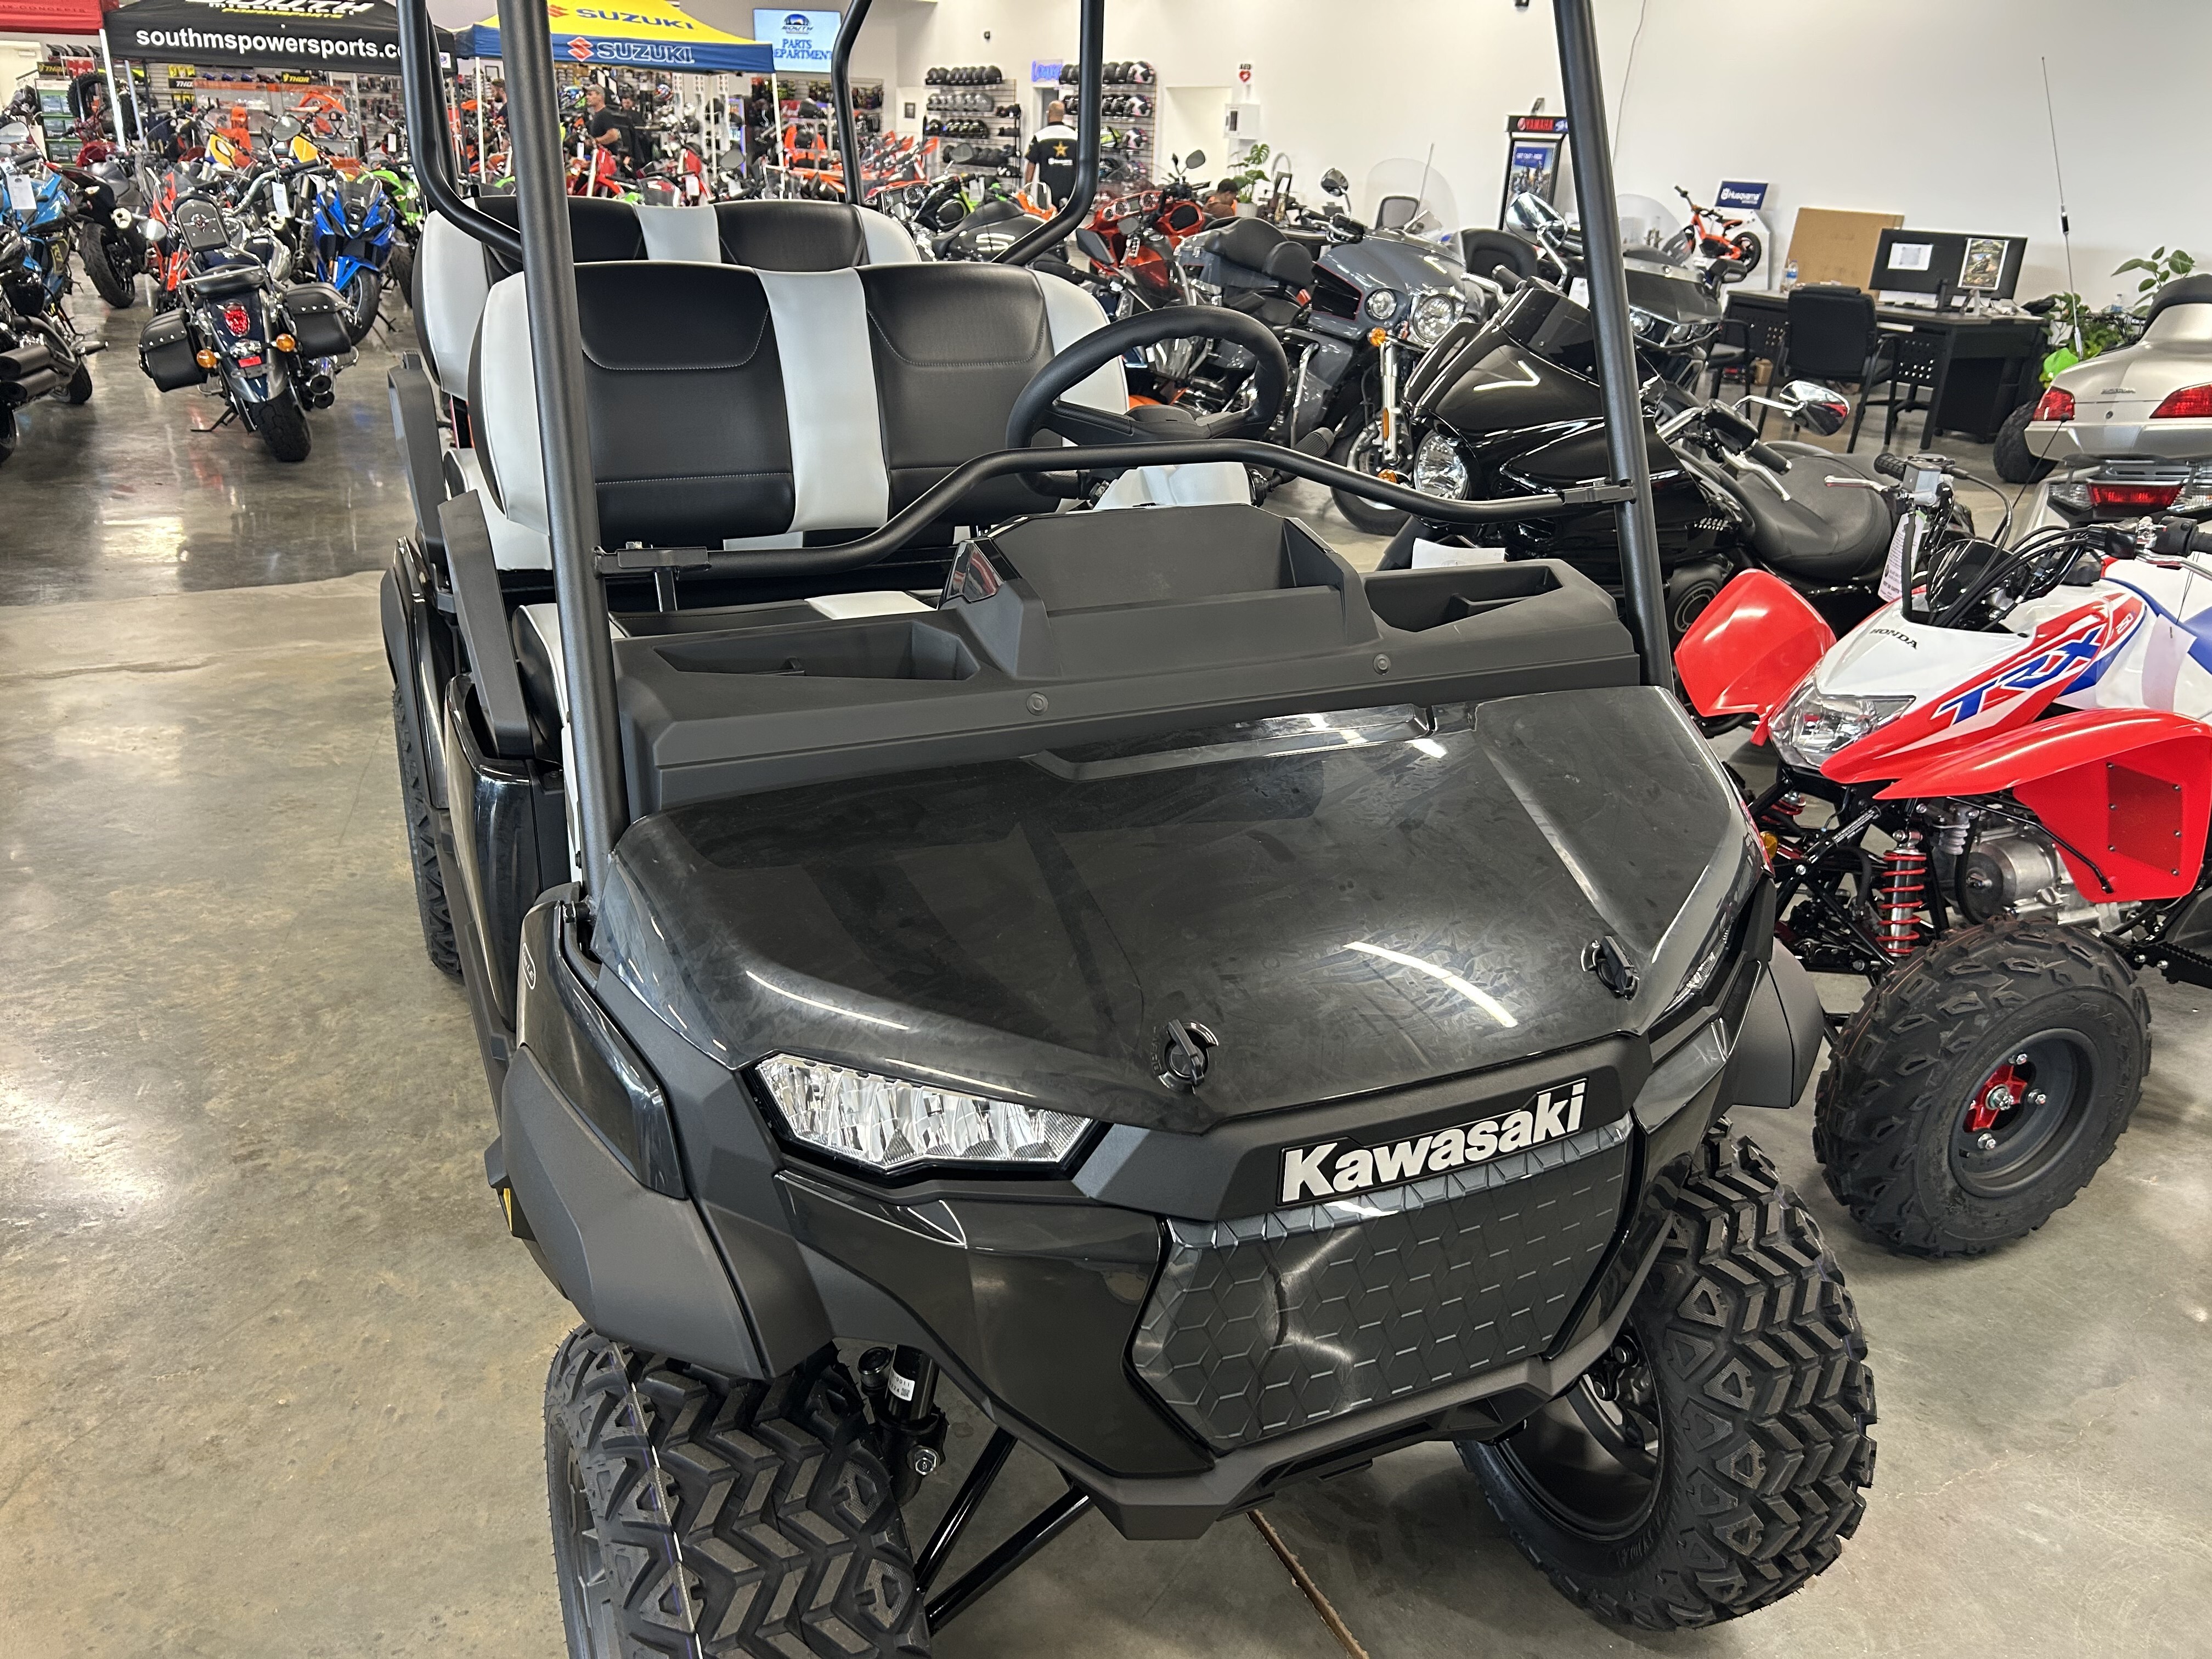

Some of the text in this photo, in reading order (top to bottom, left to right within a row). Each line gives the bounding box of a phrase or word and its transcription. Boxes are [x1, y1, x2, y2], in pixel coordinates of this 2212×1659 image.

[185, 0, 375, 12] OUTH
[576, 9, 693, 30] SUZUKI
[596, 42, 696, 64] SUZUKI
[782, 38, 812, 49] PARTS
[774, 49, 833, 60] EPARTMENT
[1869, 629, 1917, 650] HONDA
[1930, 622, 2108, 726] TRX
[1282, 1081, 1587, 1203] Kawasaki
